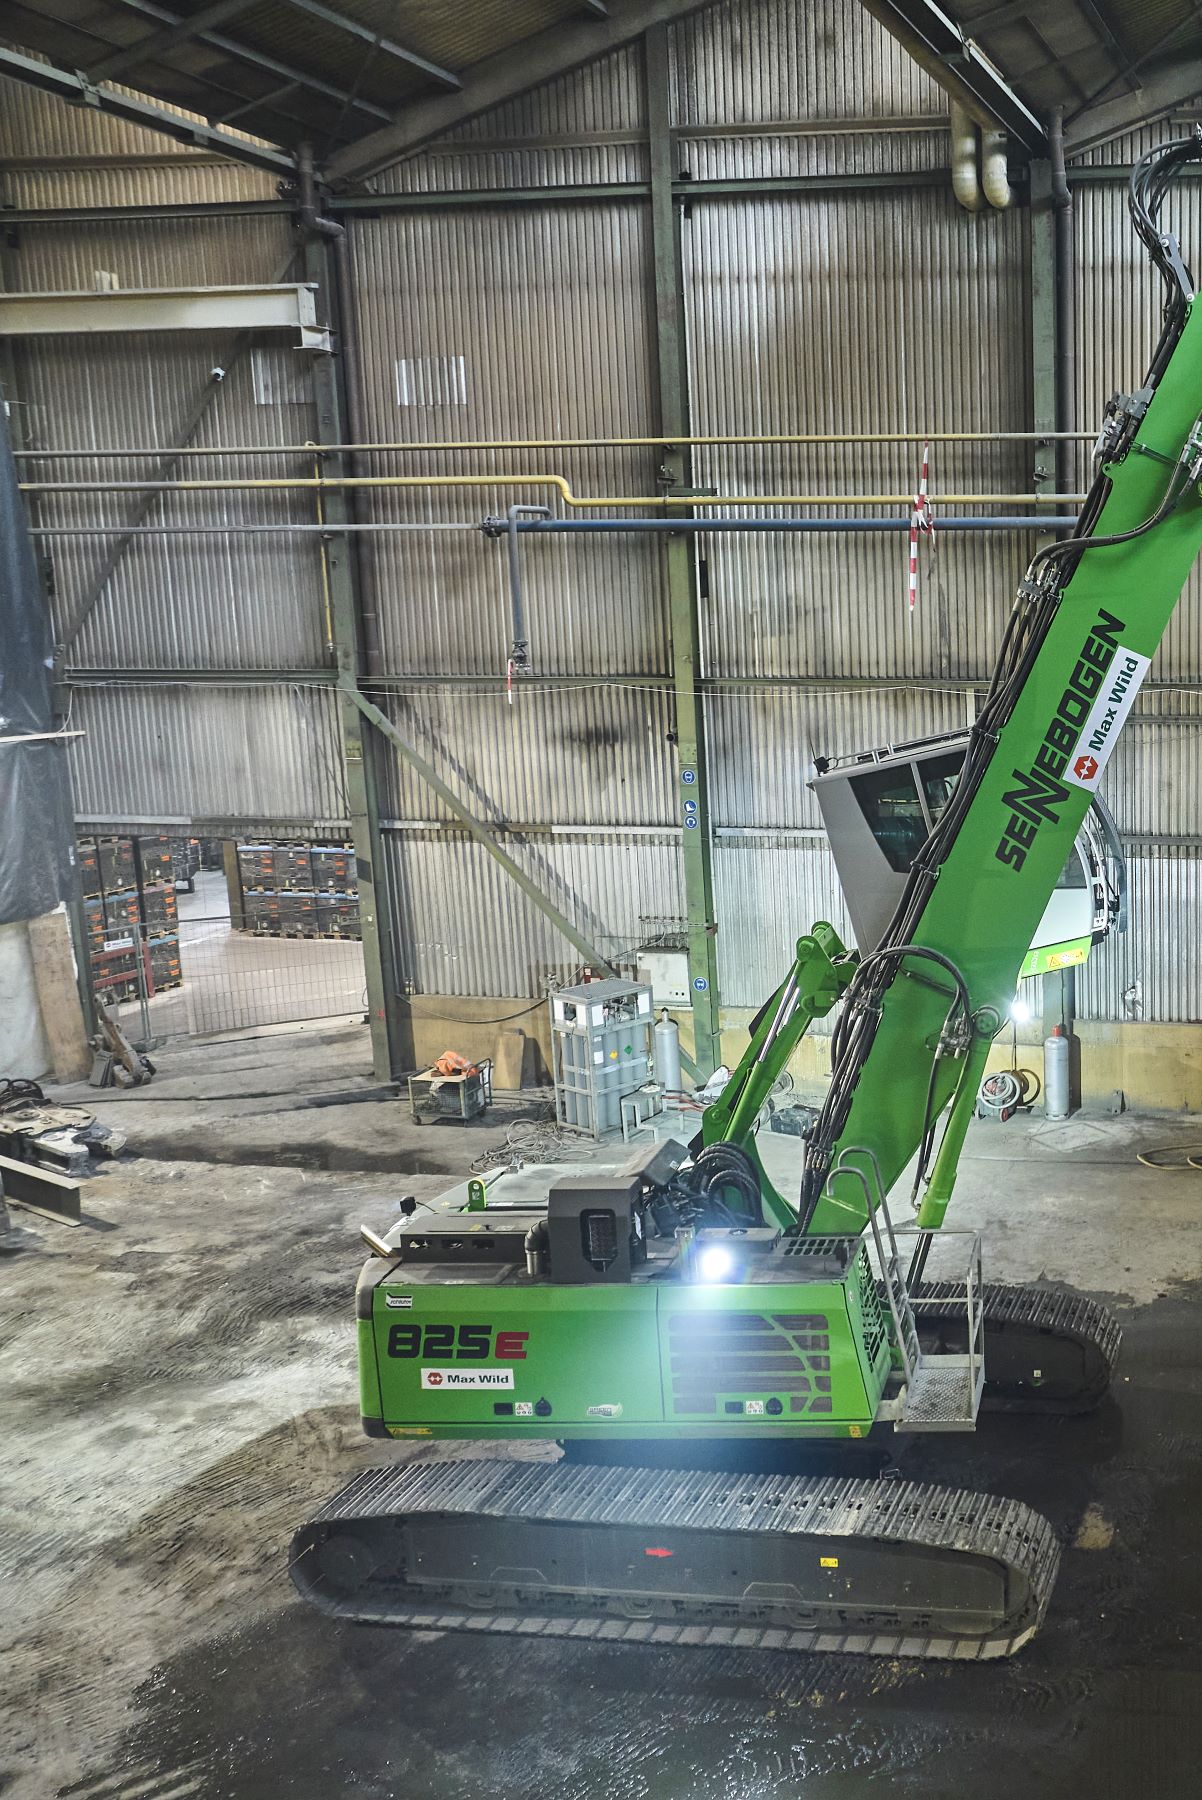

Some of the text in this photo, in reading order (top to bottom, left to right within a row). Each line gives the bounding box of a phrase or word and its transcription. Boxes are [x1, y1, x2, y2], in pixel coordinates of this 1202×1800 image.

[995, 607, 1126, 872] SENNEBOGEN
[1088, 656, 1139, 752] Max Wild
[447, 1374, 509, 1383] Max Wild
